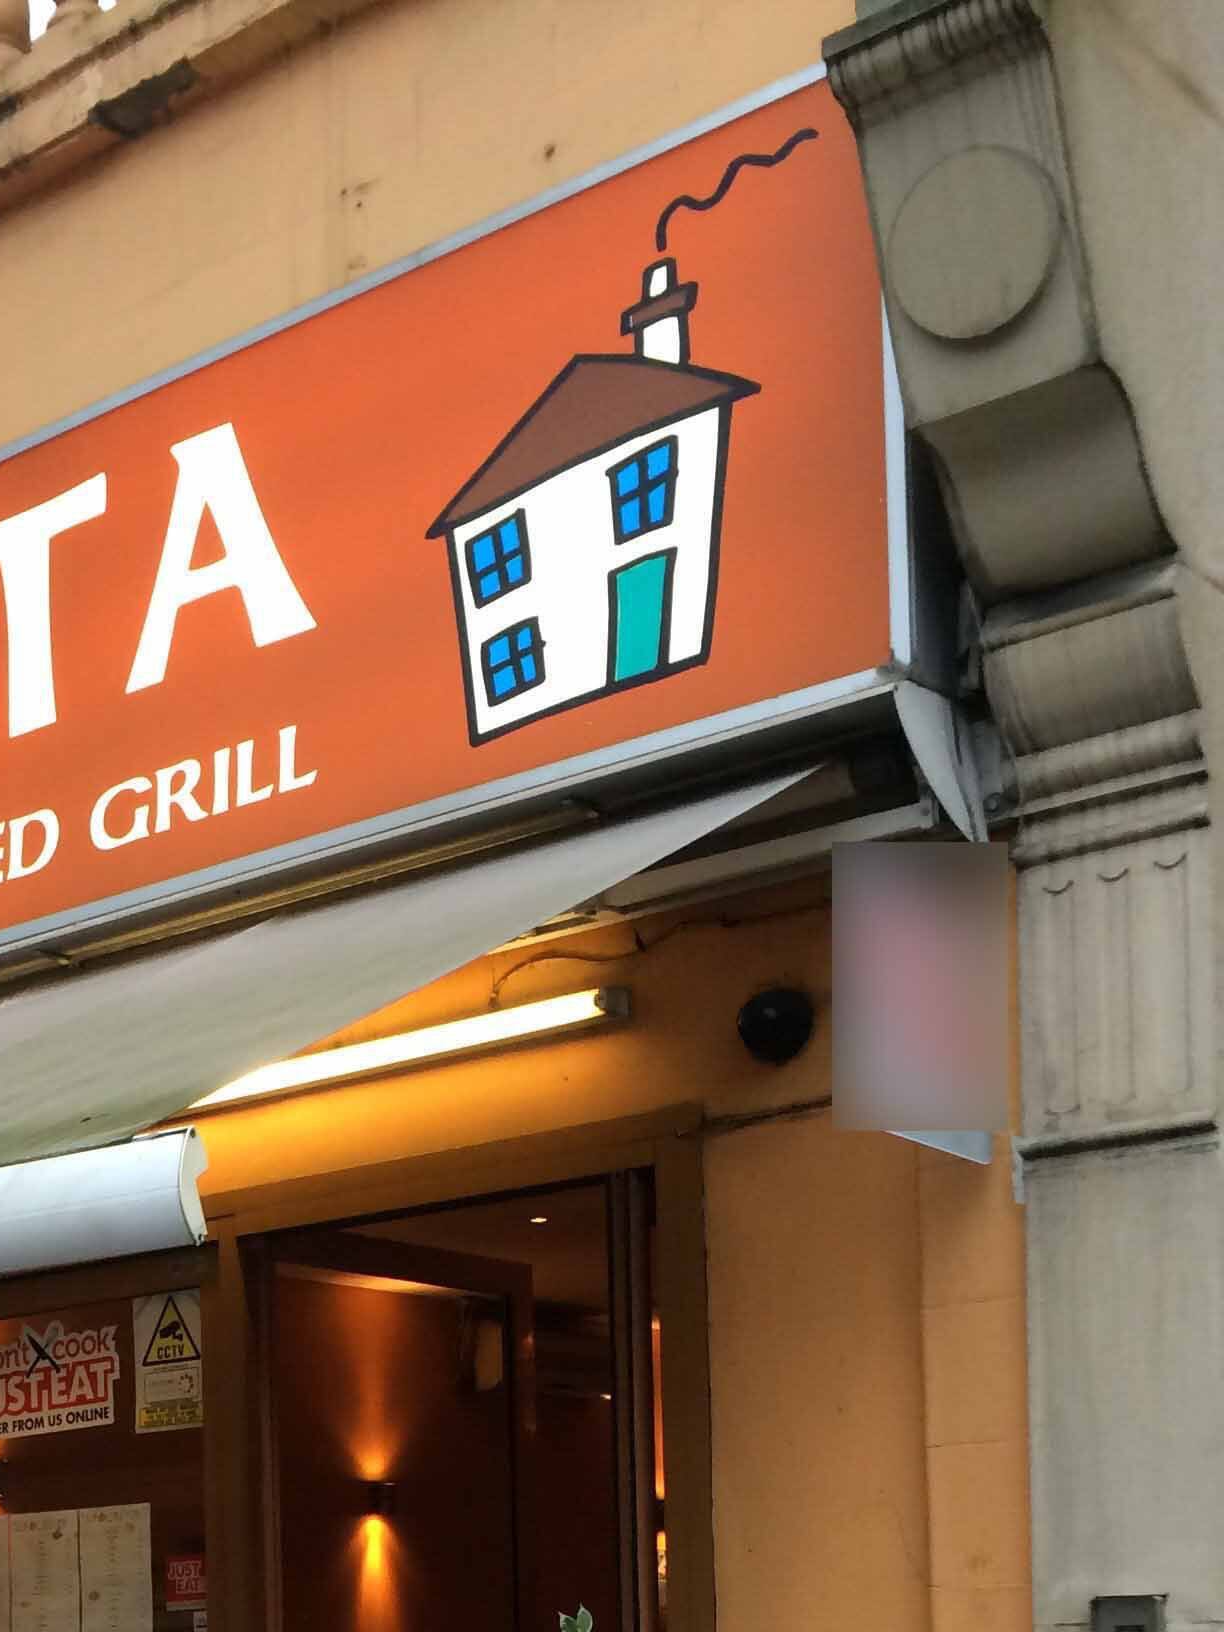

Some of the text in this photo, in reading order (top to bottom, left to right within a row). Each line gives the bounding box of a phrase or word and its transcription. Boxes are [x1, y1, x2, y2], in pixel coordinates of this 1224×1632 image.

[89, 725, 317, 851] GRILL
[157, 1343, 185, 1360] CCTV
[50, 1361, 112, 1405] EAT
[12, 1416, 45, 1432] FROM
[48, 1413, 63, 1426] US
[65, 1406, 110, 1425] ONLINE
